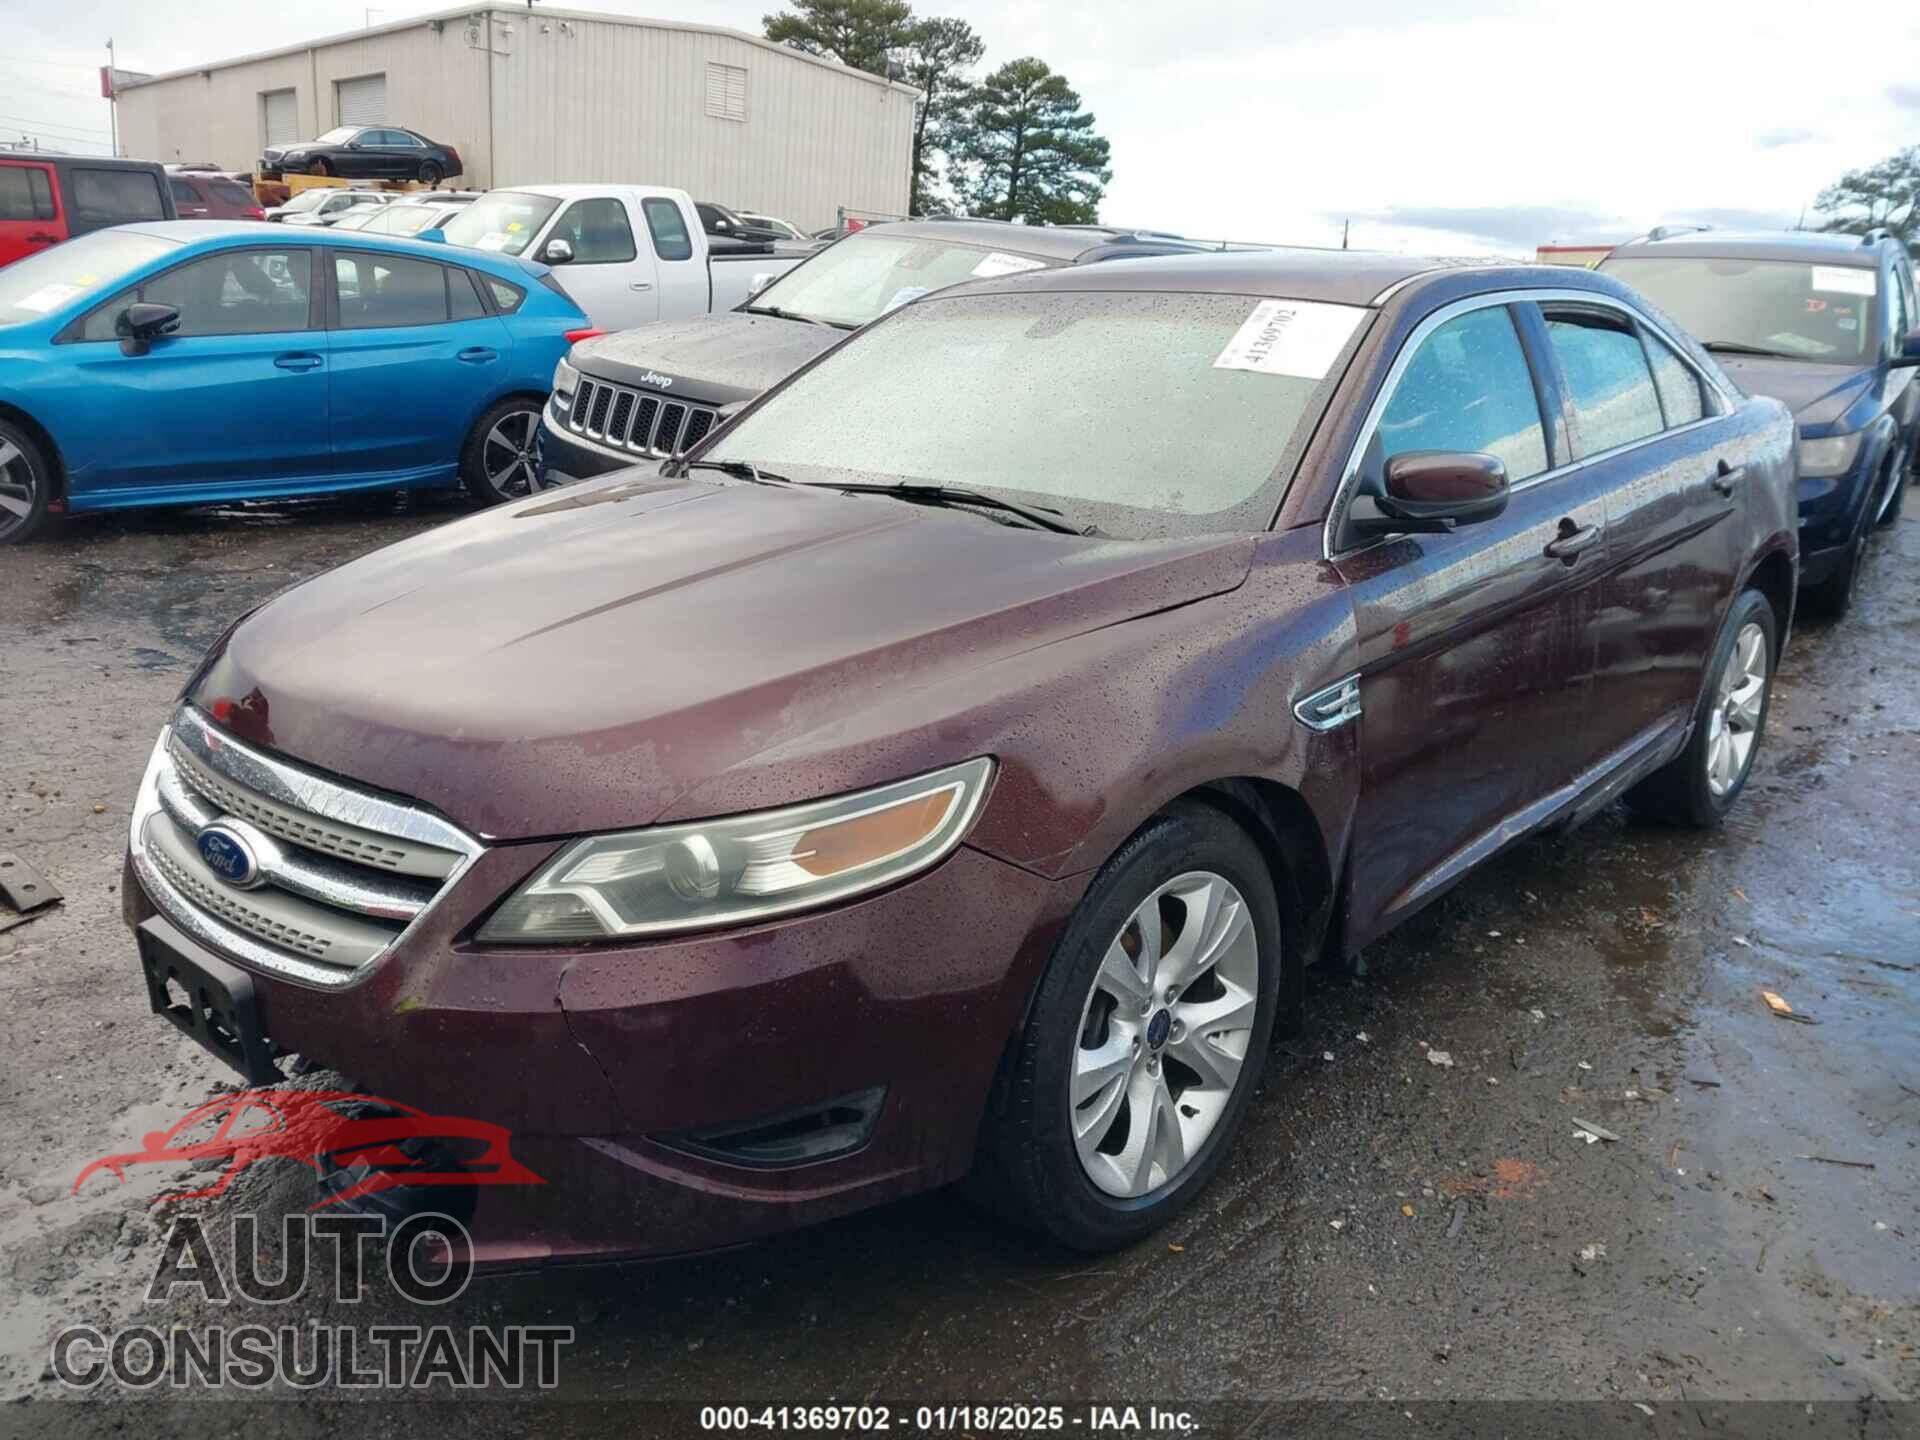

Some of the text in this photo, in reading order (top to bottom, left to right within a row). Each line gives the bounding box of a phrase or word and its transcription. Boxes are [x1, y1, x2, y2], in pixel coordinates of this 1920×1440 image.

[1245, 308, 1297, 364] 41369702
[640, 370, 673, 389] Jeep
[204, 836, 238, 873] Ford
